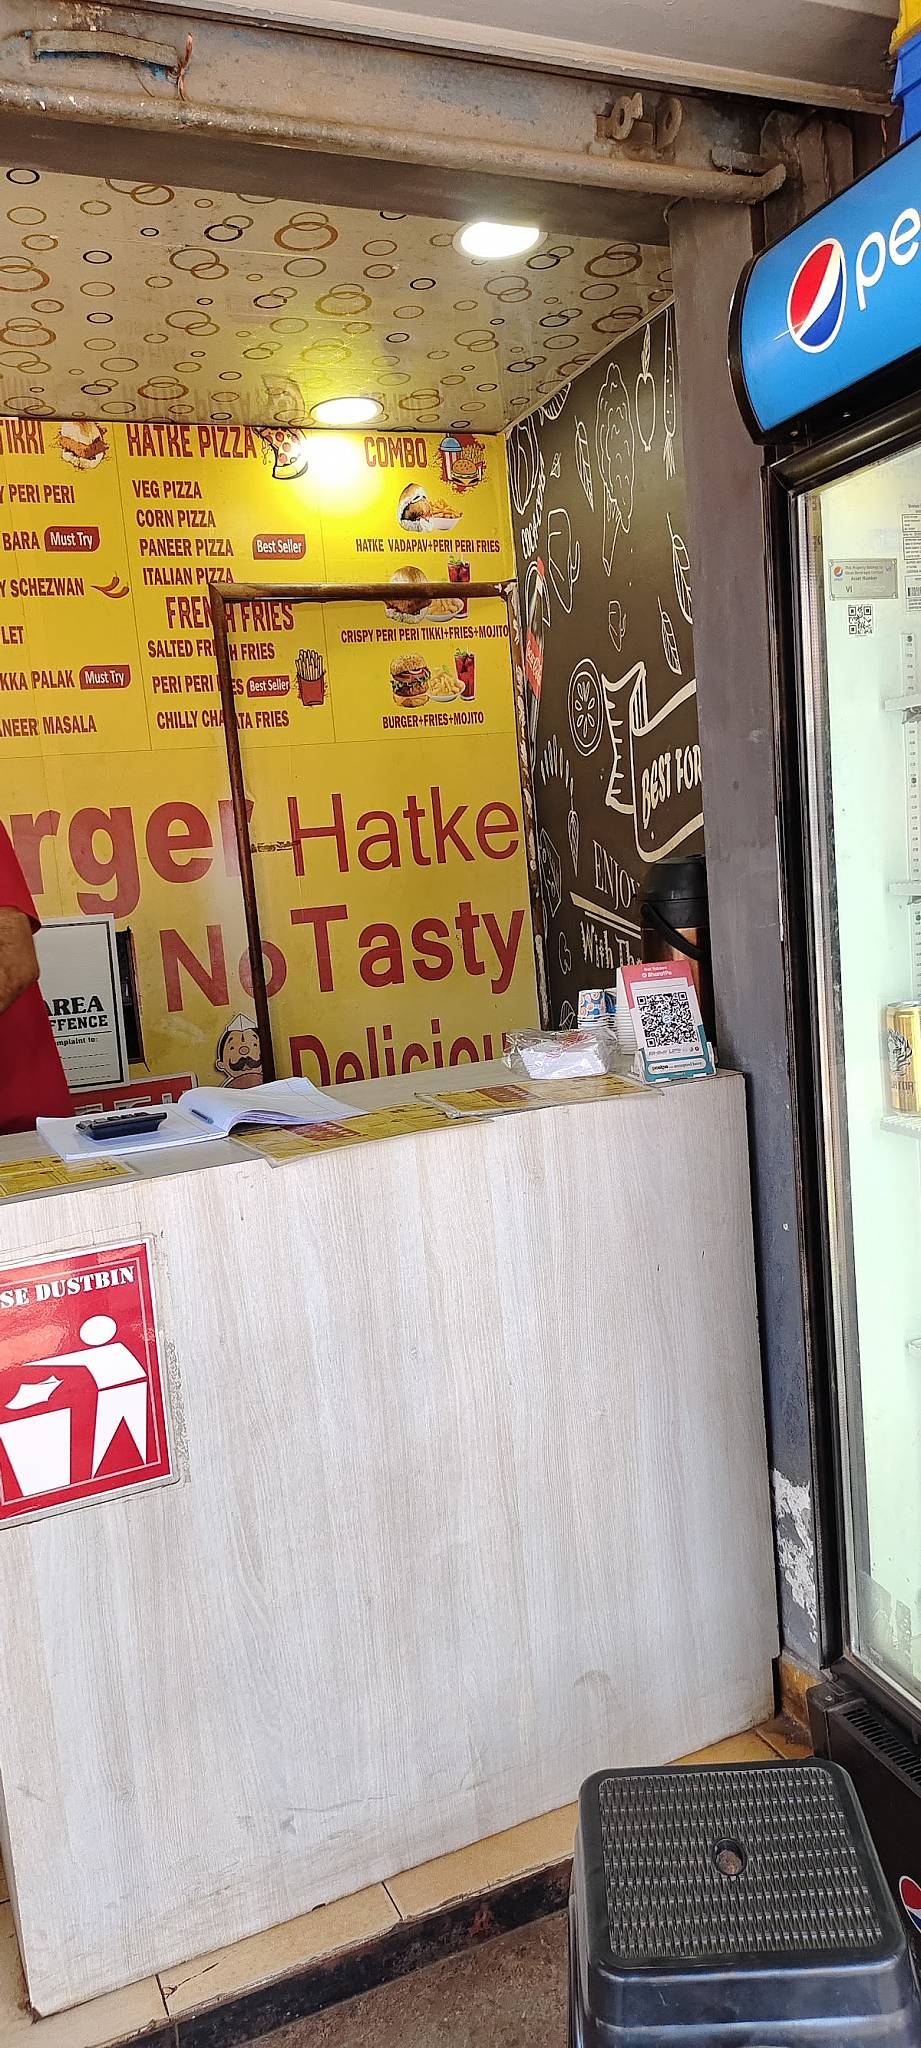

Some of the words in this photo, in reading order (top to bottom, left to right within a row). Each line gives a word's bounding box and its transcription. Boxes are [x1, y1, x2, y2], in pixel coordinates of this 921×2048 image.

[855, 208, 921, 311] pe
[126, 424, 193, 458] HATKE
[200, 424, 258, 459] PIZZA
[364, 437, 428, 467] COMBO
[9, 485, 41, 504] PERI
[43, 485, 75, 504] PERI
[132, 480, 160, 498] VEG
[164, 480, 202, 499] PIZZA
[136, 509, 174, 528] CORN
[178, 510, 216, 528] PIZZA
[3, 532, 40, 551] BARA
[50, 532, 74, 546] Must
[75, 532, 93, 549] Try
[140, 538, 192, 556] PANEER
[196, 539, 234, 557] PIZZA
[257, 538, 276, 554] Best
[277, 539, 302, 554] Seller
[356, 539, 384, 552] HATKE
[455, 539, 474, 552] PERI
[476, 539, 500, 552] FRIES
[143, 568, 192, 585] ITALIAN
[196, 568, 234, 584] PIZZA
[11, 578, 85, 598] SCHEZWAN
[166, 596, 236, 633] FRENH
[241, 601, 294, 632] FRIES
[341, 628, 373, 643] CRISPY
[376, 627, 397, 642] PERI
[400, 627, 419, 641] PERI
[148, 640, 194, 658] SALTED
[241, 643, 274, 660] FRIES
[32, 670, 75, 689] PALAK
[85, 671, 107, 685] Must
[108, 671, 124, 686] Try
[153, 677, 182, 694] PERI
[185, 675, 214, 693] PERI
[250, 678, 266, 692] Best
[267, 676, 289, 691] Seller
[43, 715, 97, 734] MASALA
[157, 711, 198, 729] CHILLY
[255, 710, 289, 728] FRIES
[641, 752, 671, 830] BEST
[287, 787, 520, 877] Hatke
[291, 902, 525, 994] Tasty
[580, 921, 614, 970] With
[35, 1266, 135, 1301] DUSTBIN
